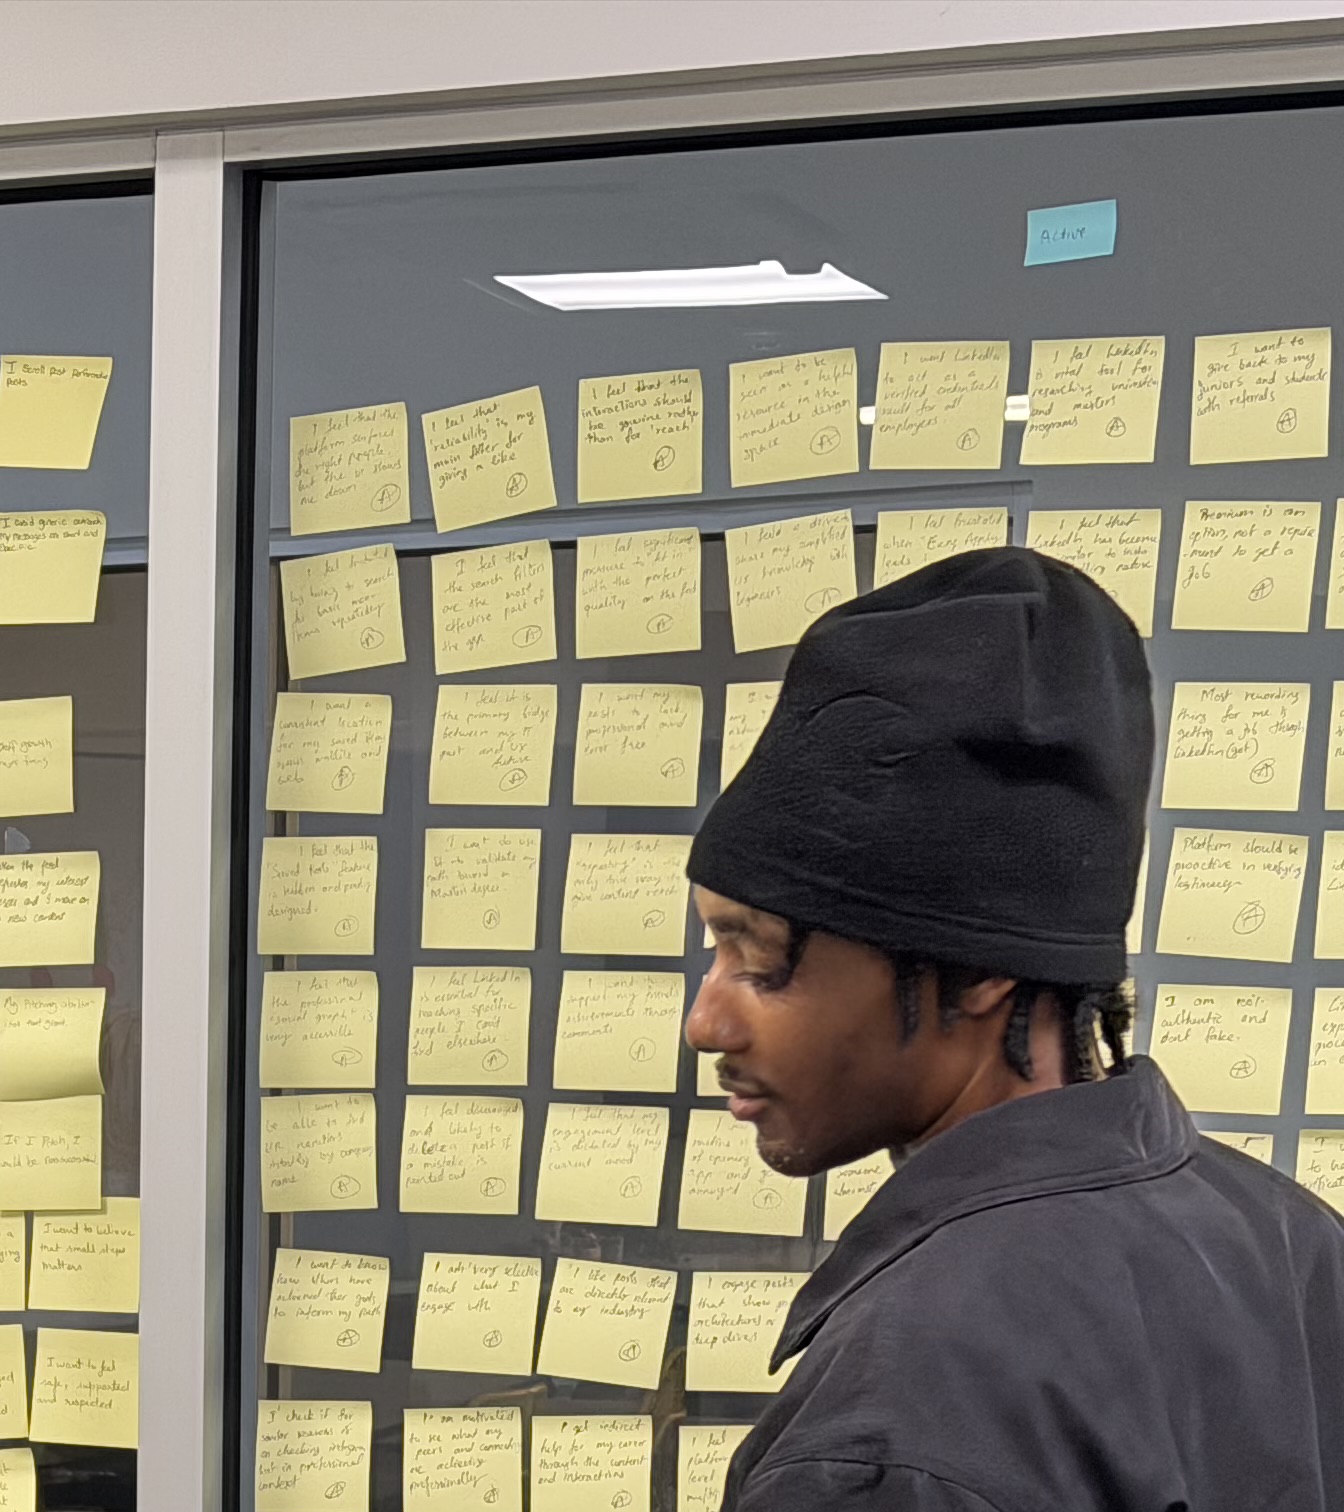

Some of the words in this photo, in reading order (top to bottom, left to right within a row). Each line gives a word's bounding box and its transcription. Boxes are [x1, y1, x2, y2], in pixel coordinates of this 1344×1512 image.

[1255, 340, 1283, 354] want
[1290, 336, 1304, 347] to
[1207, 360, 1230, 377] give
[1240, 353, 1268, 369] back
[1275, 353, 1289, 365] to
[1294, 353, 1315, 371] my
[1256, 369, 1277, 385] and
[607, 382, 626, 399] feel
[635, 381, 662, 395] that
[670, 375, 691, 387] the
[582, 398, 648, 416] interactions
[653, 390, 693, 407] should
[1230, 387, 1276, 406] referrals
[585, 430, 615, 445] than
[1193, 996, 1215, 1007] am
[1240, 1010, 1269, 1025] and
[6, 1231, 15, 1239] a
[47, 1357, 55, 1368] I
[56, 1358, 81, 1370] want
[87, 1357, 96, 1370] to
[76, 1378, 130, 1398] supported
[36, 1396, 57, 1406] and
[65, 1396, 113, 1413] respected
